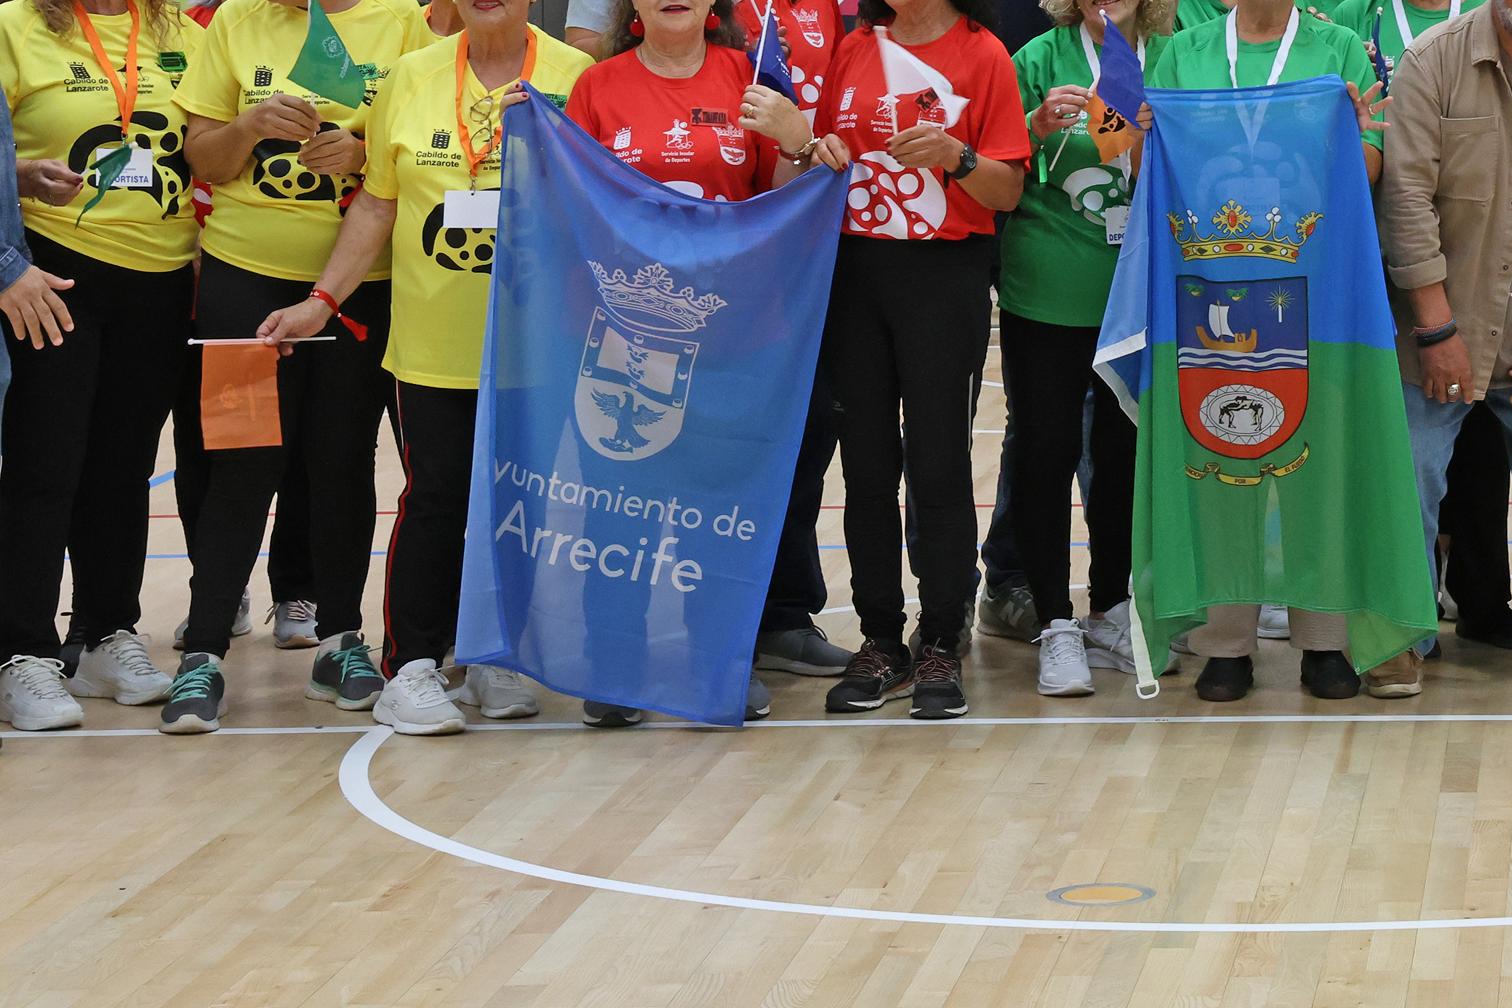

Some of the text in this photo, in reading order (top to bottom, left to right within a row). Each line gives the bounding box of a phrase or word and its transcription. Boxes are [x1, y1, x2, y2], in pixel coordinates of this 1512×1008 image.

[66, 85, 109, 93] Lanzarote
[415, 150, 462, 160] Cabildo de
[416, 158, 460, 168] Lanzarote
[495, 456, 756, 541] yuntamiento de
[495, 499, 703, 593] Arrecife
